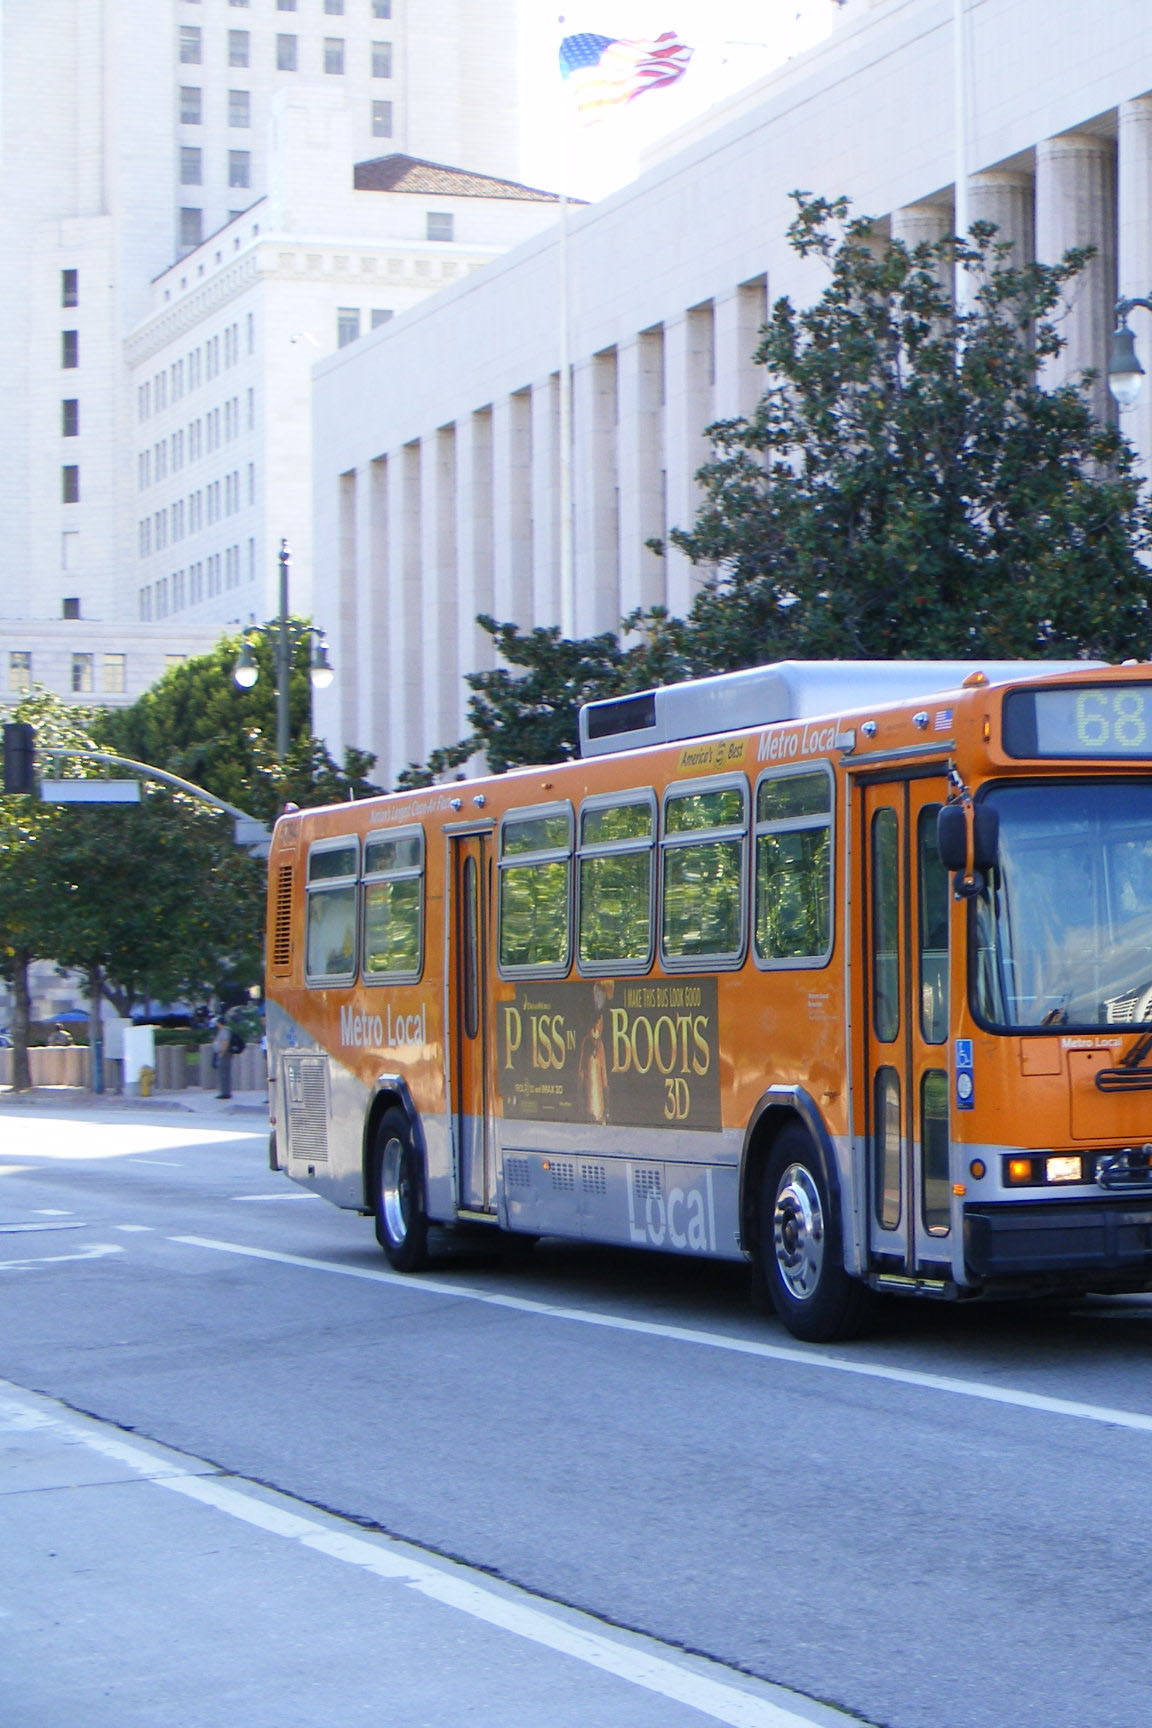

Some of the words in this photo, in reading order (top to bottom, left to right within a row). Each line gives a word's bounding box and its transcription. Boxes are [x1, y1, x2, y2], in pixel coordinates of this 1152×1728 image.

[1076, 690, 1146, 747] 68
[727, 743, 744, 760] Best
[757, 727, 798, 762] Metro
[801, 719, 841, 755] Local
[340, 1005, 382, 1046] Metro
[386, 1002, 426, 1046] Local
[566, 1030, 576, 1051] IN
[610, 1007, 710, 1076] BOOTS
[1061, 1038, 1093, 1049] Metro
[1095, 1037, 1123, 1048] Local
[664, 1077, 690, 1120] 3D
[626, 1162, 717, 1252] Local
